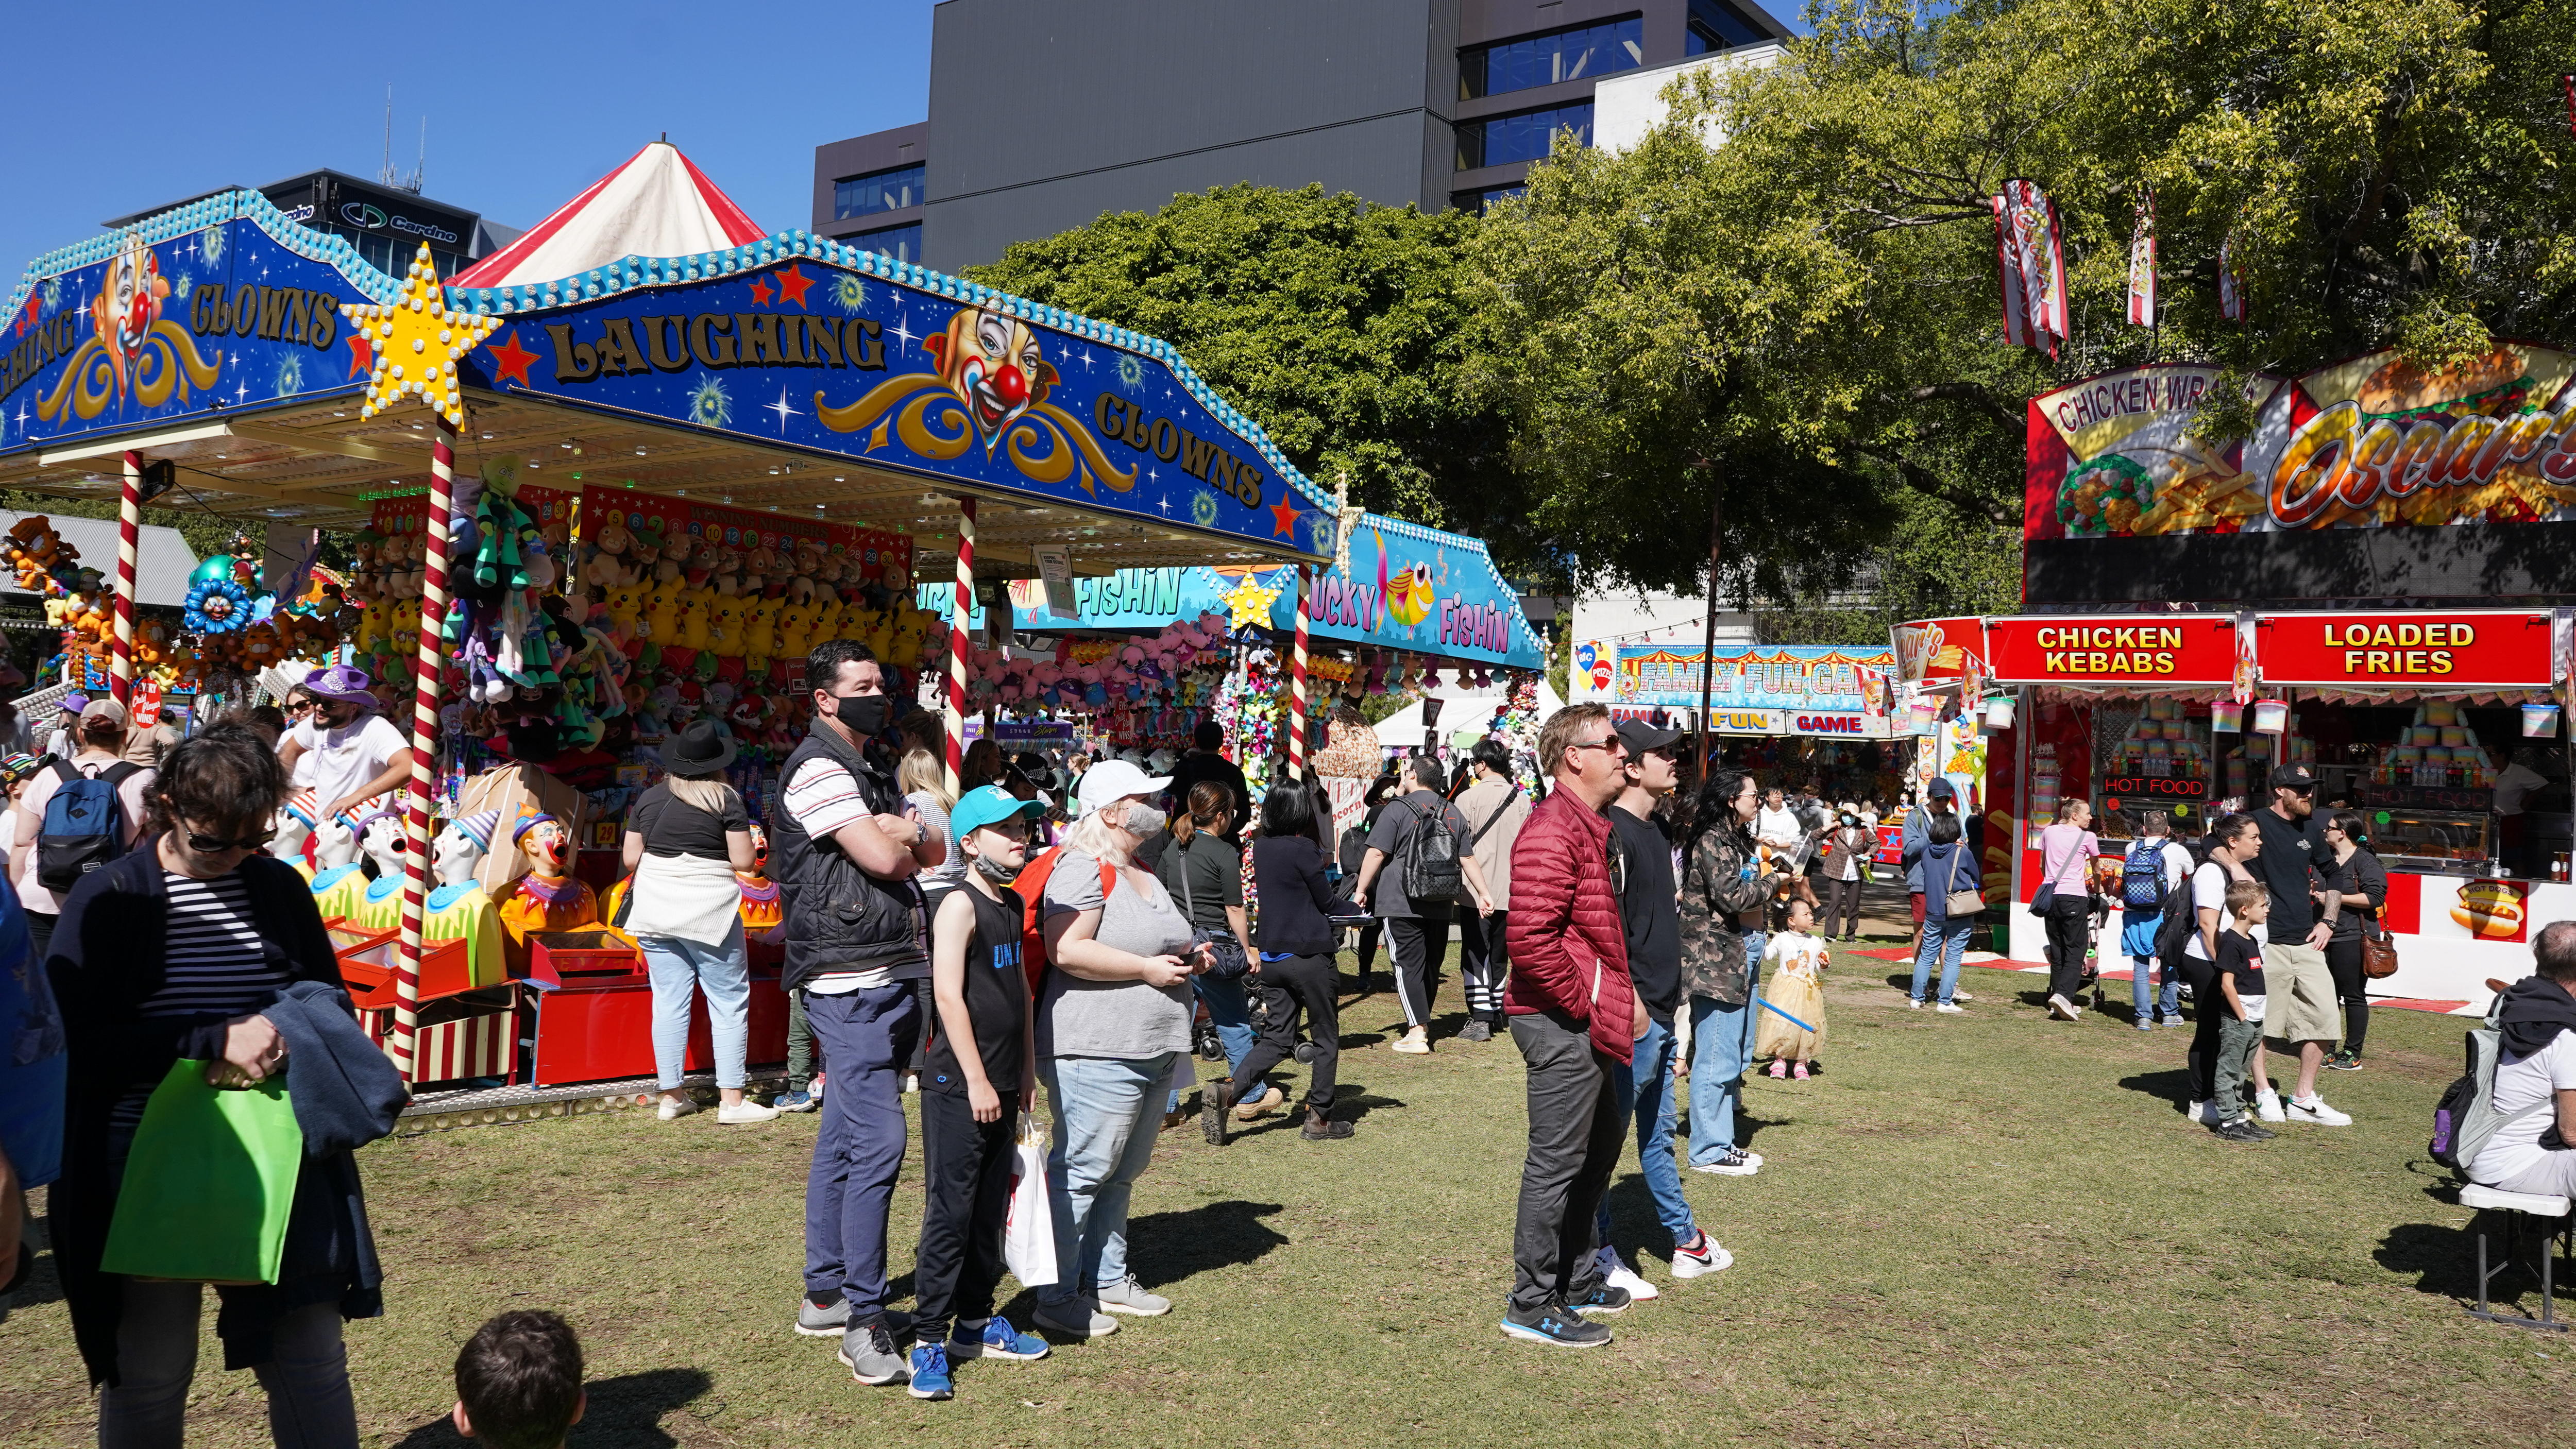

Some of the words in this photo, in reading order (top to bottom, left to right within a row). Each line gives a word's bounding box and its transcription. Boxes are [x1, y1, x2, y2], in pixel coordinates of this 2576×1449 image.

[390, 215, 457, 243] Cardno
[190, 283, 340, 352] CLOWNS
[545, 312, 887, 385] LAUGHING
[1094, 391, 1264, 509] CLOWNS
[2058, 376, 2159, 434] CHICKEN
[543, 506, 552, 515] 29
[555, 505, 564, 514] 30
[690, 505, 755, 529] WINNING
[758, 516, 829, 539] NUMBERS
[708, 527, 719, 539] 10
[727, 531, 738, 542] 12
[745, 533, 757, 544] 16
[764, 536, 775, 547] 22
[781, 539, 793, 550] 24
[850, 549, 861, 559] 28
[866, 551, 877, 561] 29
[882, 554, 893, 564] 30
[1309, 574, 1376, 633] UCKY
[2037, 627, 2182, 650] CHICKEN
[2324, 624, 2475, 647] LOADED
[1578, 652, 1593, 663] BIG
[2045, 651, 2176, 674] KEBABS
[2344, 651, 2453, 674] FRIES
[1592, 667, 1613, 680] PRIZES
[1745, 662, 1804, 694] FUN
[139, 682, 157, 693] EVERY
[132, 693, 147, 708] Child
[136, 712, 155, 724] WINS!
[1612, 709, 1672, 726] FAMILY
[1710, 712, 1768, 730] FUN
[1797, 715, 1863, 733] GAME
[2105, 778, 2144, 792] HOT
[2150, 779, 2203, 795] FOOD
[2371, 789, 2415, 803] HOT
[2426, 790, 2486, 807] FOOD
[600, 826, 614, 841] 29
[2104, 859, 2124, 869] DRINK
[2468, 885, 2486, 894] HOT
[2489, 886, 2514, 896] DOGS
